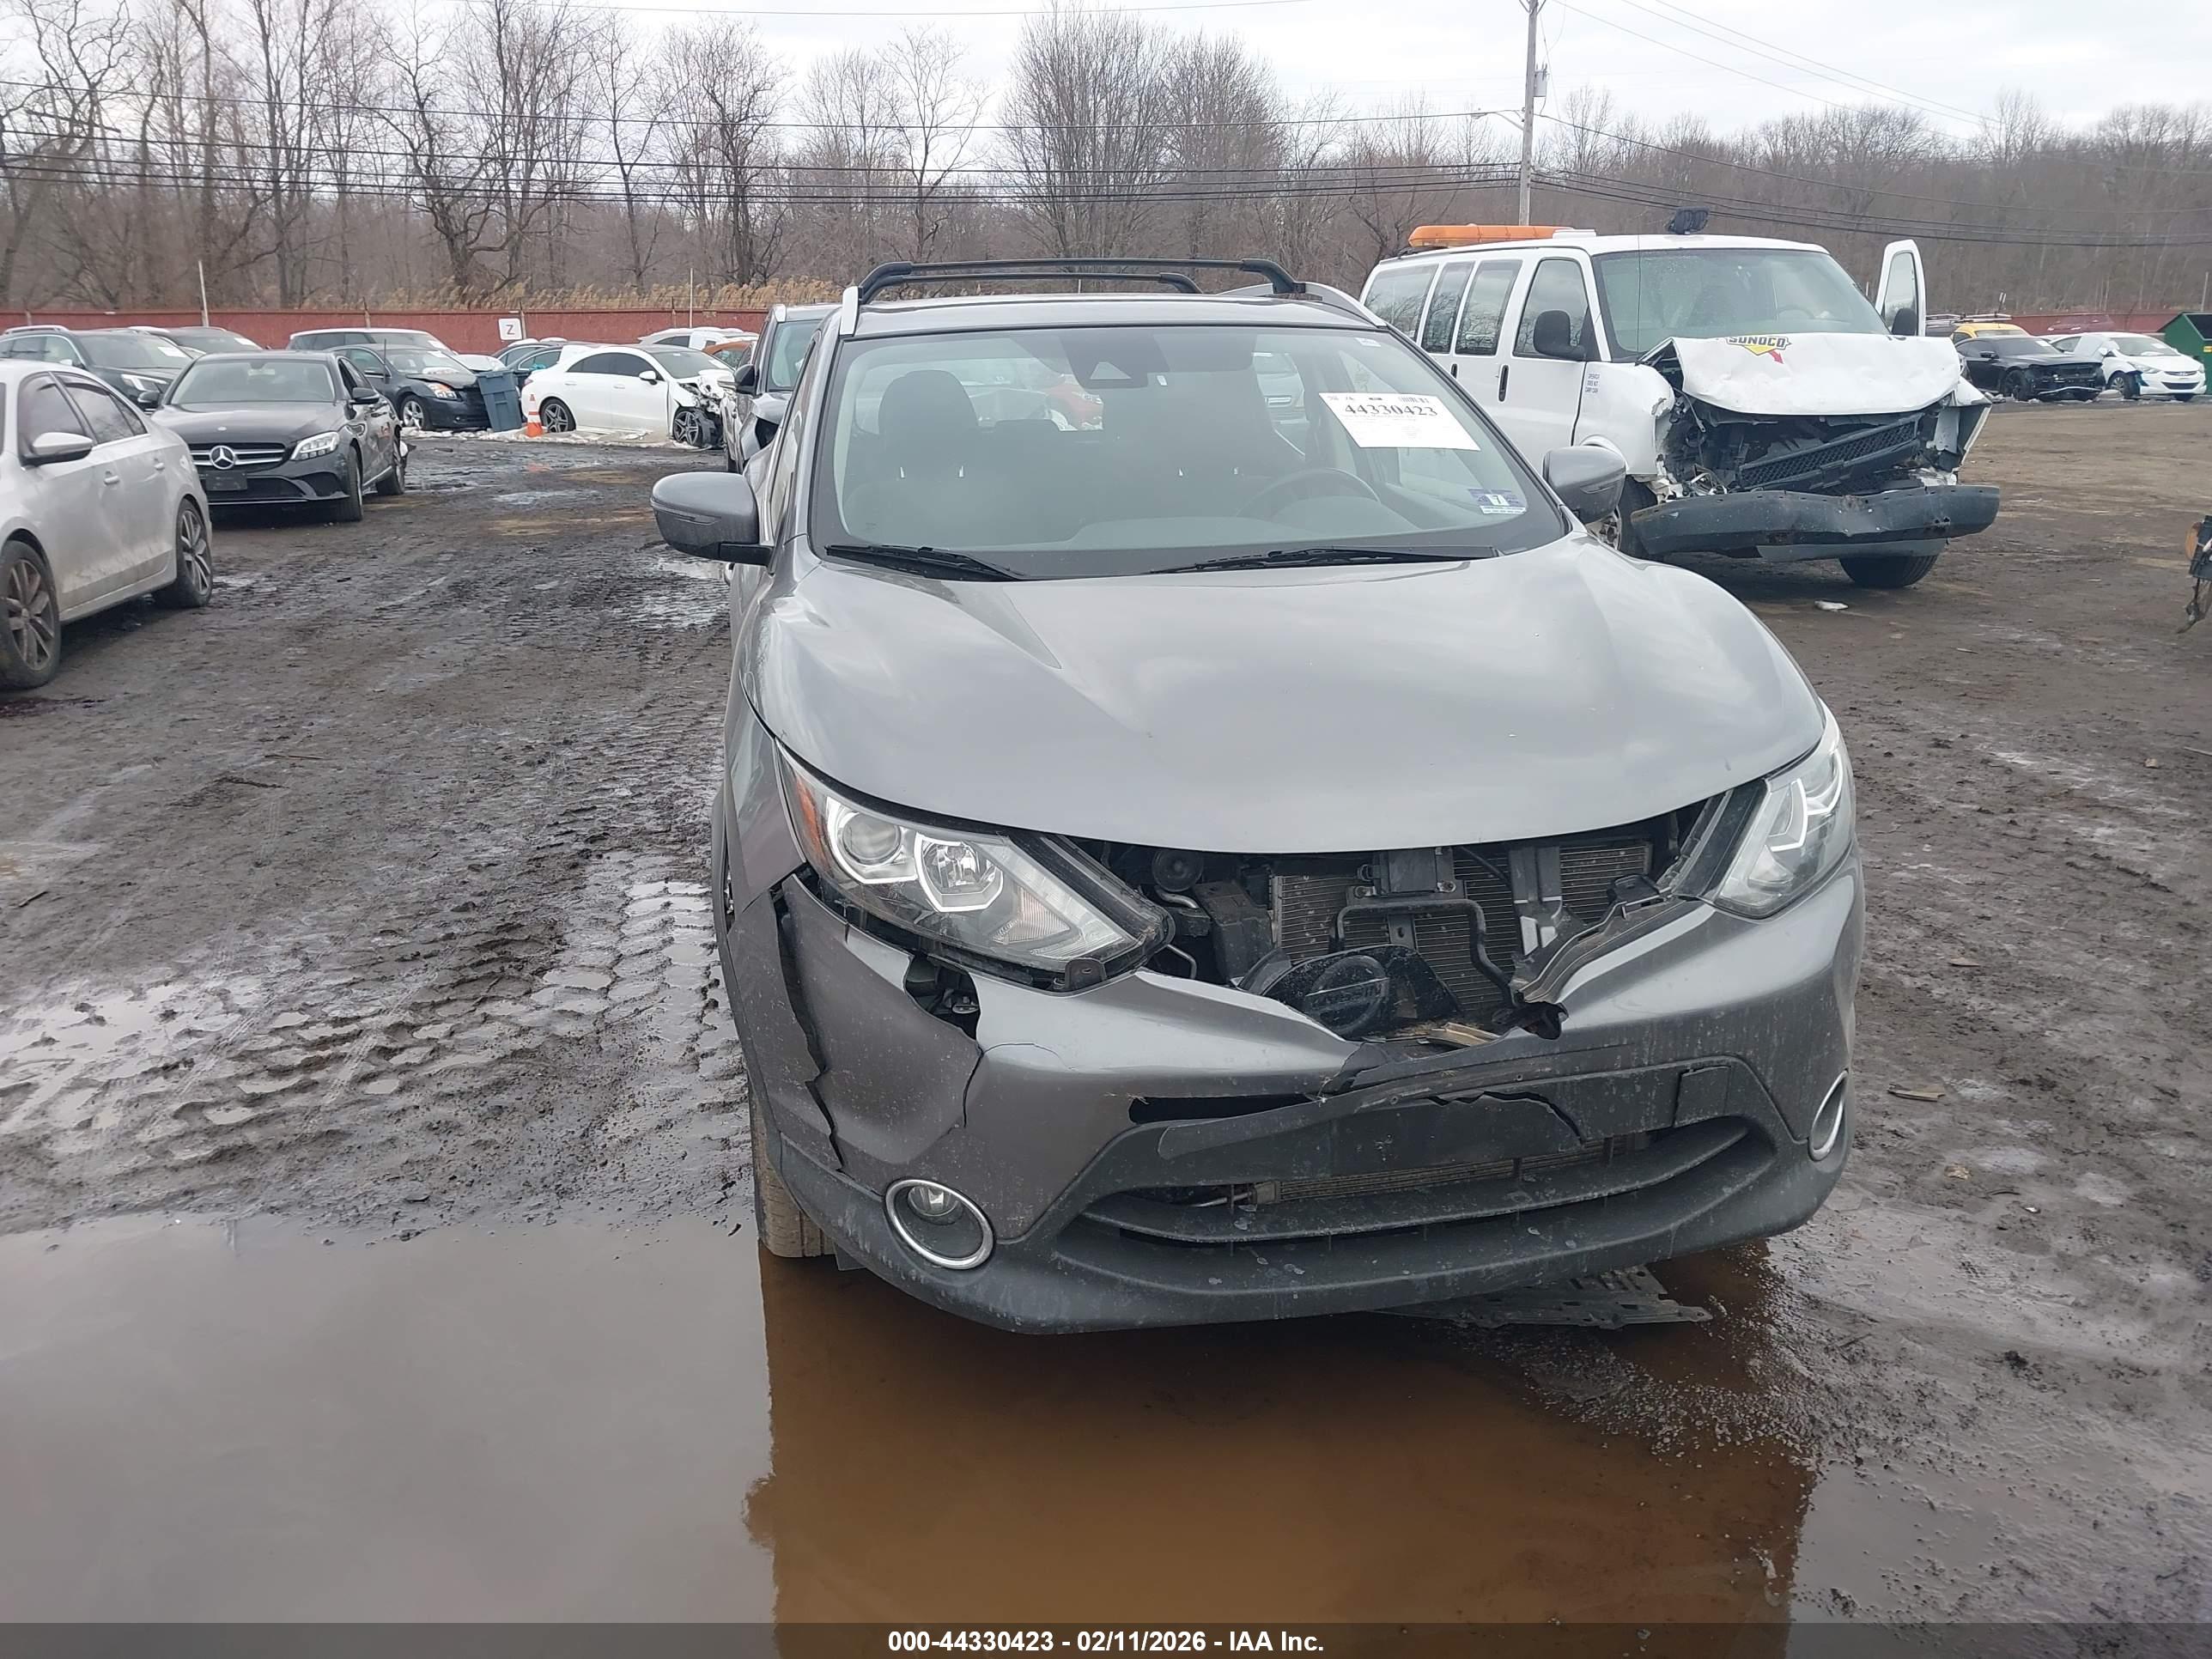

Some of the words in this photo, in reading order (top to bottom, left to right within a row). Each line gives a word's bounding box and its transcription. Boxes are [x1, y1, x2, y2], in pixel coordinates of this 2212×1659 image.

[506, 324, 515, 335] Z
[1729, 336, 1786, 348] SUNOCO
[1345, 404, 1437, 416] 44330423
